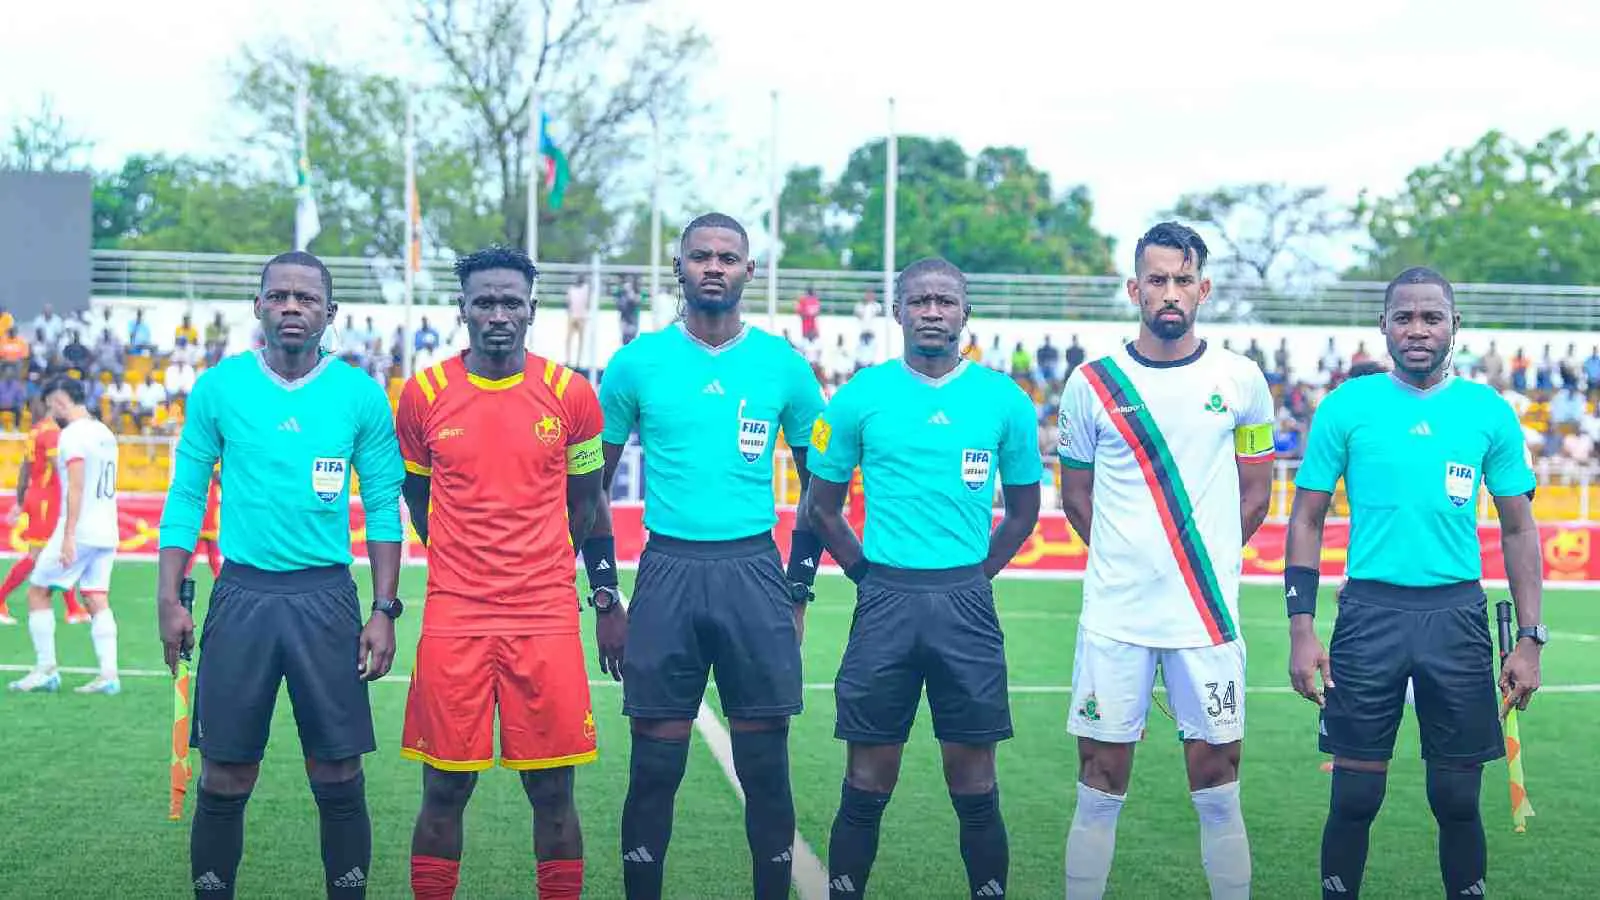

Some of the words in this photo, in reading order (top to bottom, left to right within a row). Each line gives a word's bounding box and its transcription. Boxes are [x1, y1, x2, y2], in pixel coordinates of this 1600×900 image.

[742, 421, 766, 434] FIFA
[965, 452, 989, 463] FIFA
[315, 461, 344, 473] FIFA
[1448, 466, 1472, 478] FIFA
[1205, 680, 1236, 717] 34
